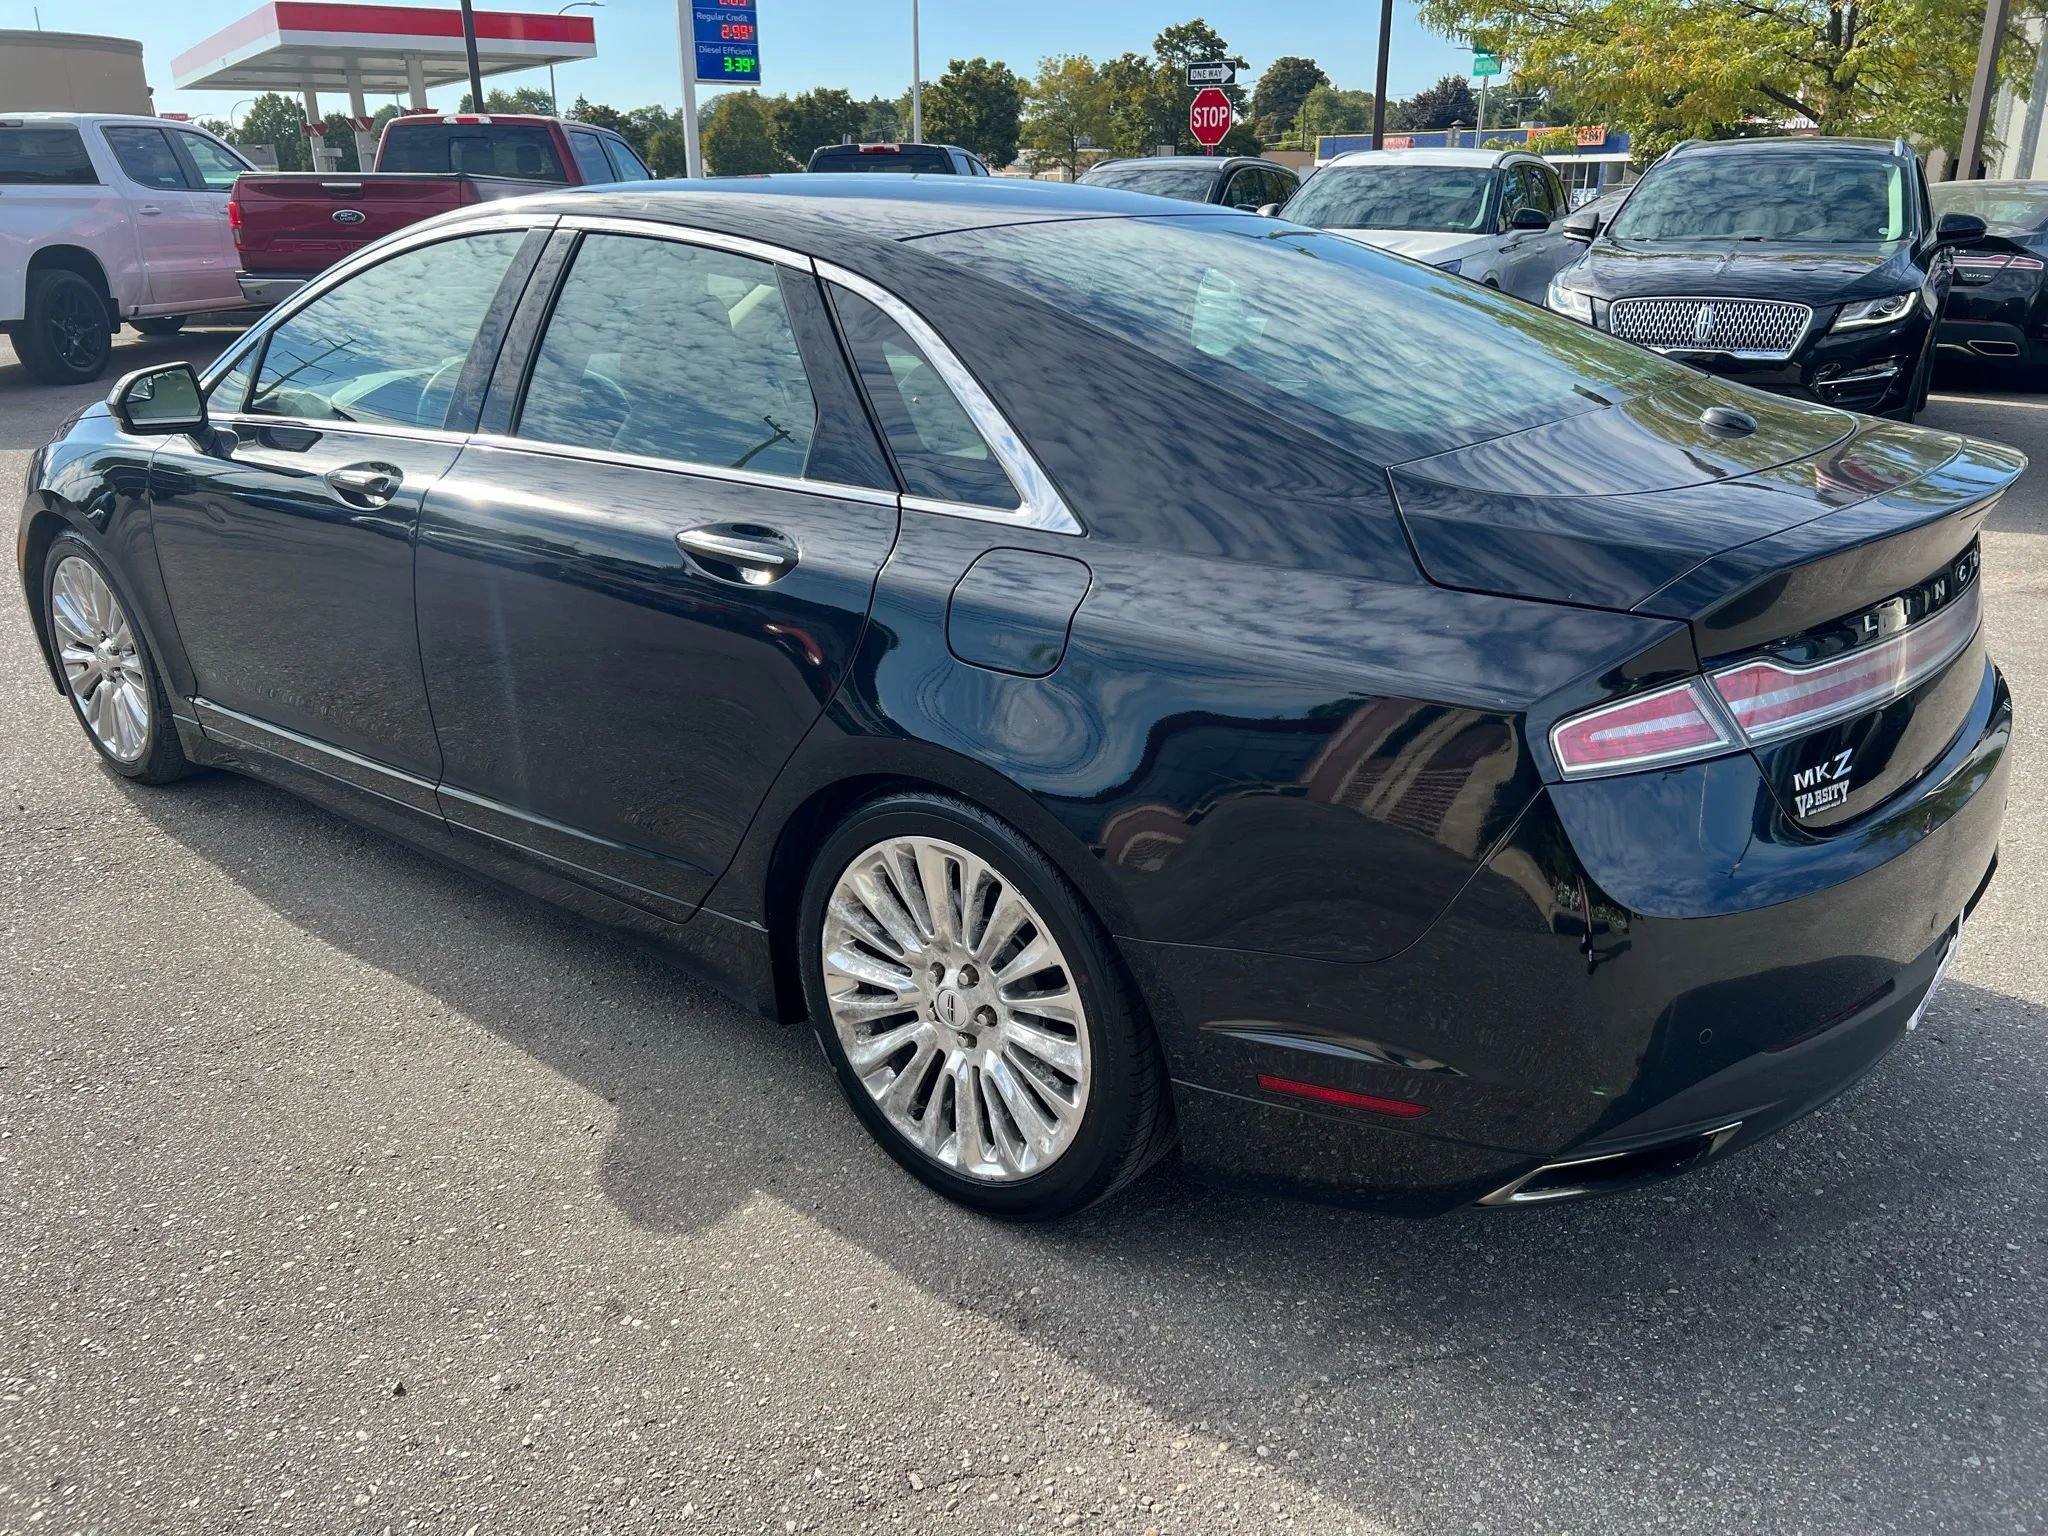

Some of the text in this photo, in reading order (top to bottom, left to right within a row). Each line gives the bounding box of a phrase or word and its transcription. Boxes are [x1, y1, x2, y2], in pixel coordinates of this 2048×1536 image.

[696, 12, 748, 22] Regular Credit
[699, 46, 752, 55] Diesel Efficient
[1192, 69, 1222, 79] ONE WAY
[1193, 106, 1228, 128] STOP
[1785, 117, 1807, 129] AUTO
[1793, 748, 1853, 792] MKZ
[1794, 780, 1850, 818] VARSITY
